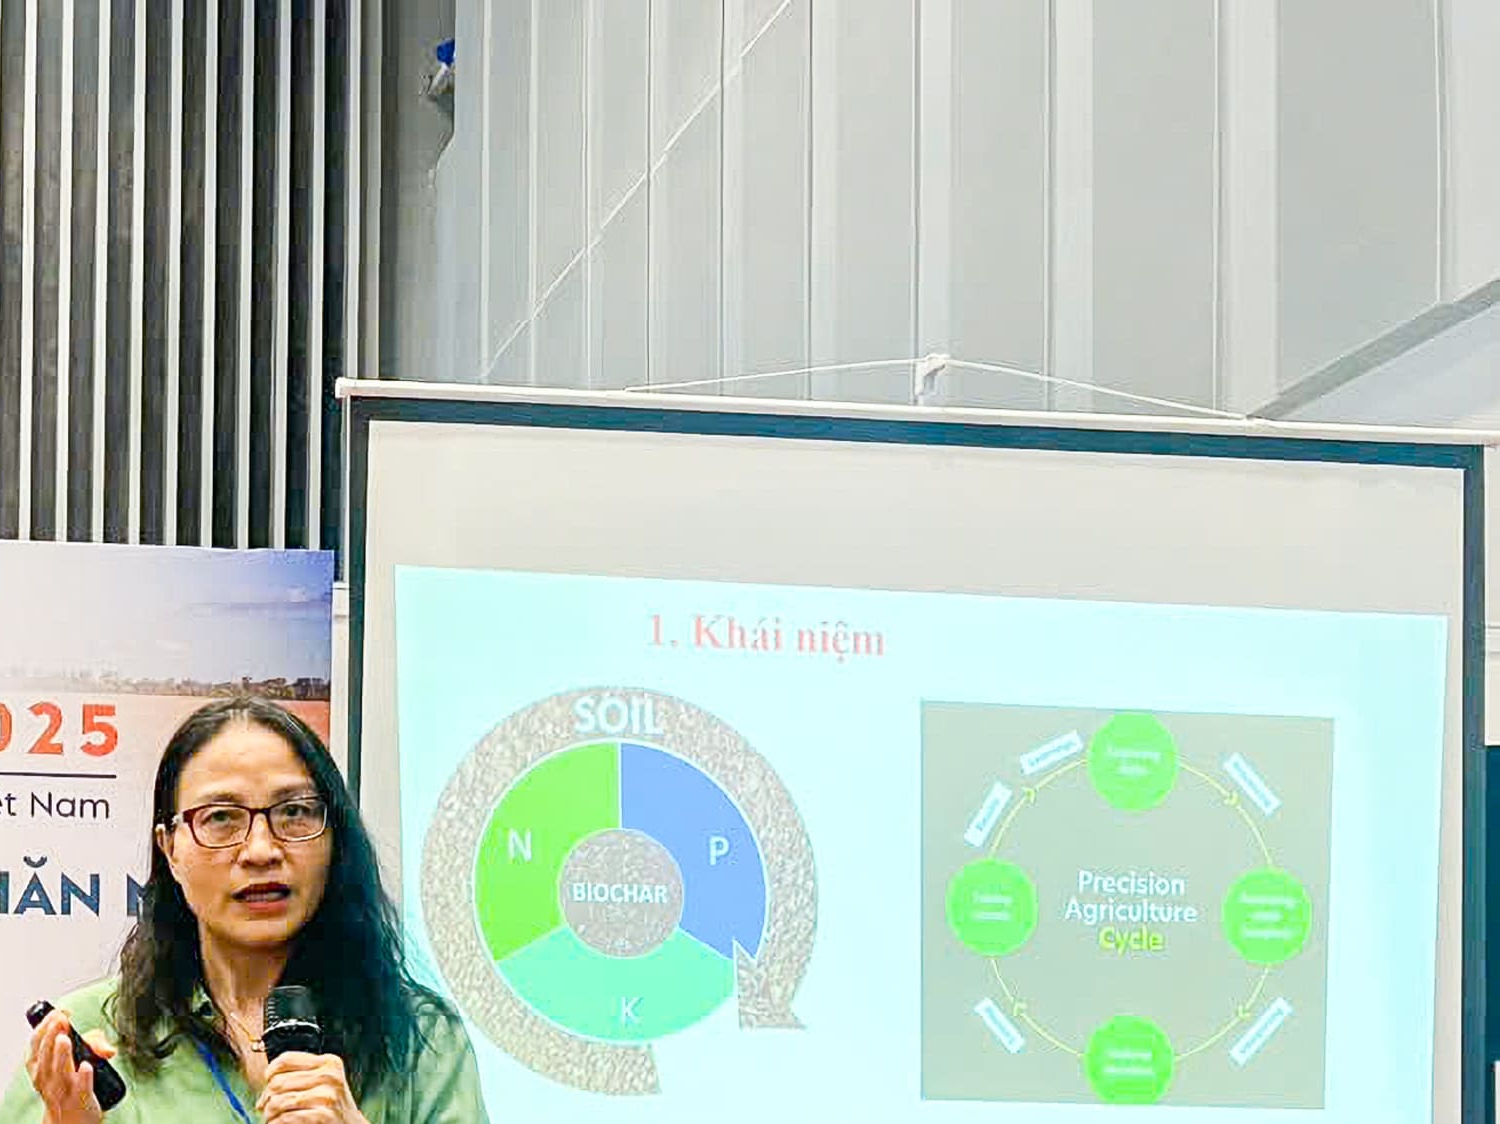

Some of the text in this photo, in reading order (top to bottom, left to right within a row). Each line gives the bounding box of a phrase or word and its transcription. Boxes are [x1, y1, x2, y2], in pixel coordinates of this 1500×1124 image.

[649, 613, 885, 664] 1. Khái niệm
[573, 695, 666, 735] SOIL
[31, 792, 109, 819] Nam
[507, 828, 730, 866] N P
[572, 883, 668, 904] BIOCHAR
[1078, 869, 1185, 895] Precision
[1064, 898, 1198, 924] Agriculture
[1098, 924, 1165, 957] Cycle
[620, 997, 640, 1024] K
